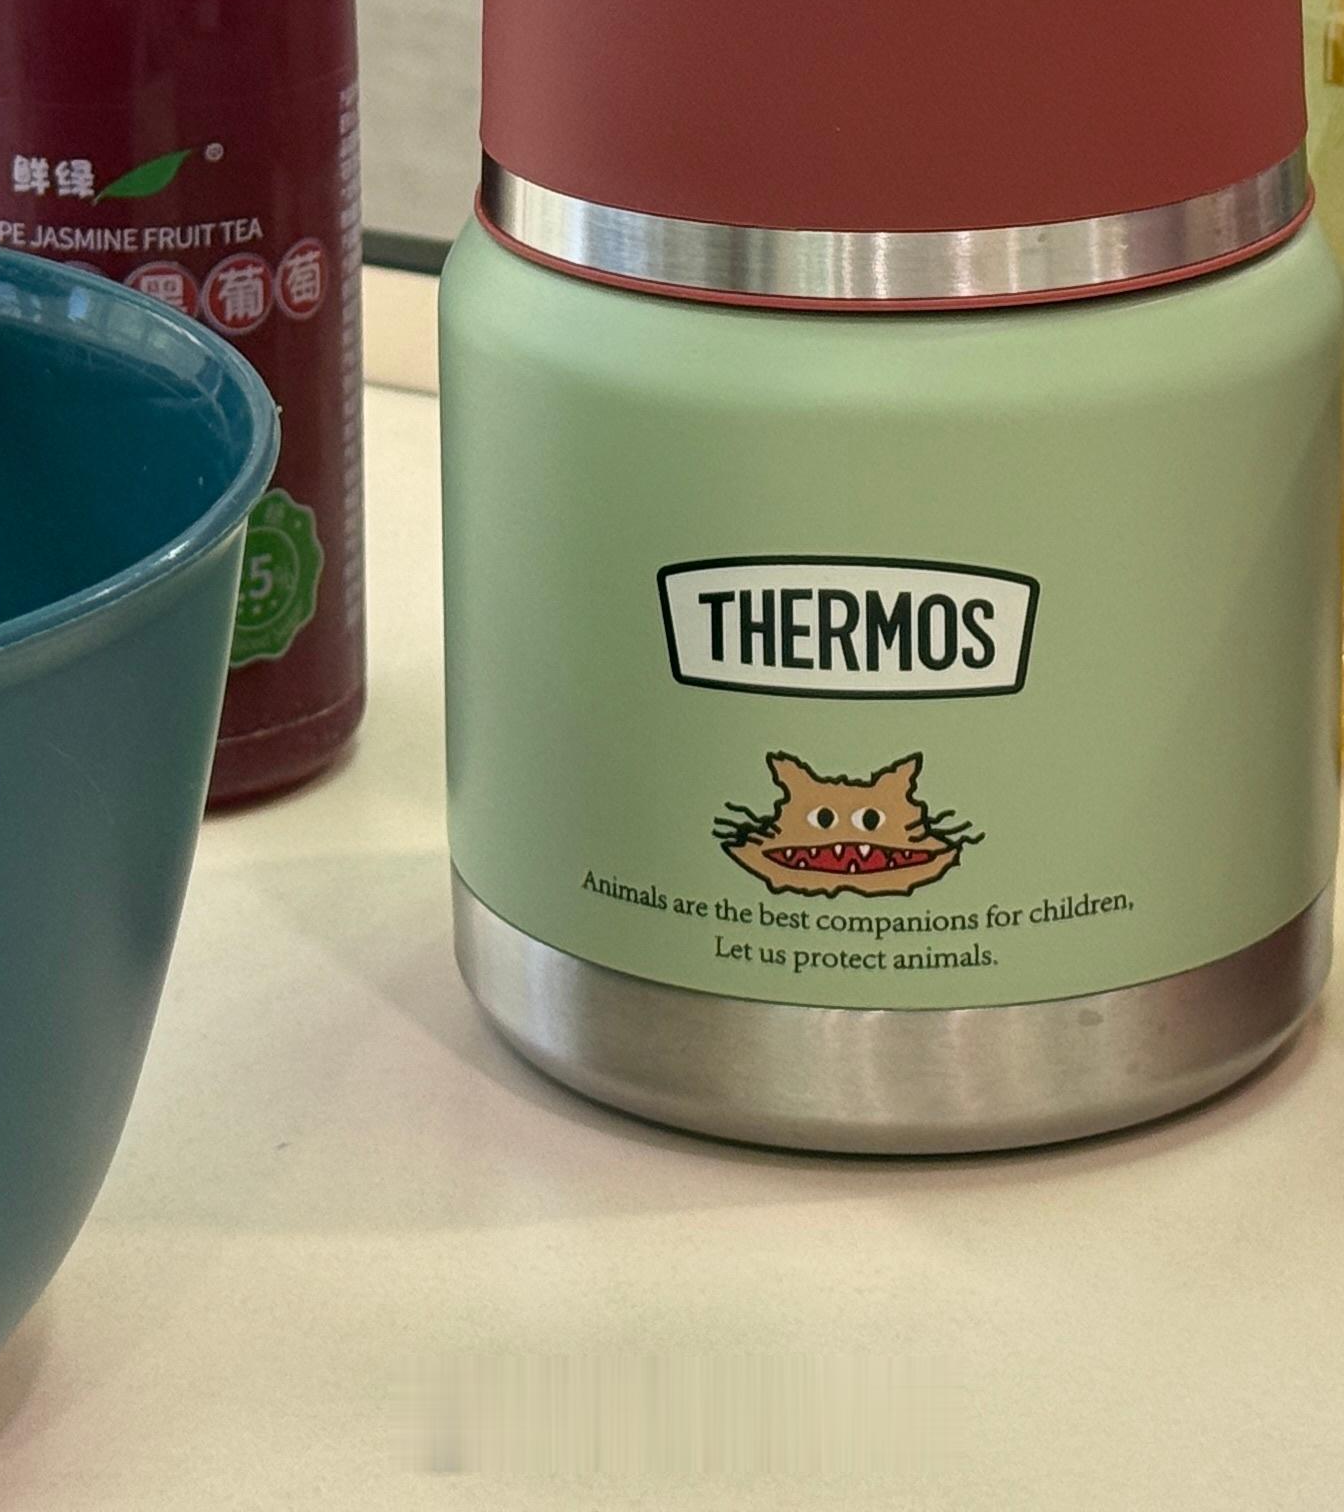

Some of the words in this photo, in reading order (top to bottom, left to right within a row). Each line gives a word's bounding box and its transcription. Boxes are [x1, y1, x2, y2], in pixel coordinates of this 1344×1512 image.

[30, 224, 139, 252] JASMINE
[143, 222, 216, 251] FRUIT
[220, 217, 264, 244] TEA
[697, 587, 997, 674] THERMOS
[581, 868, 668, 912] Animals
[673, 896, 709, 918] are
[714, 898, 753, 925] the
[758, 901, 812, 931] best
[816, 909, 980, 940] companions
[985, 904, 1023, 930] for
[1030, 890, 1135, 925] children,
[714, 936, 753, 963] Let
[758, 944, 787, 965] us
[793, 941, 887, 973] protect
[893, 940, 1000, 970] animals.
